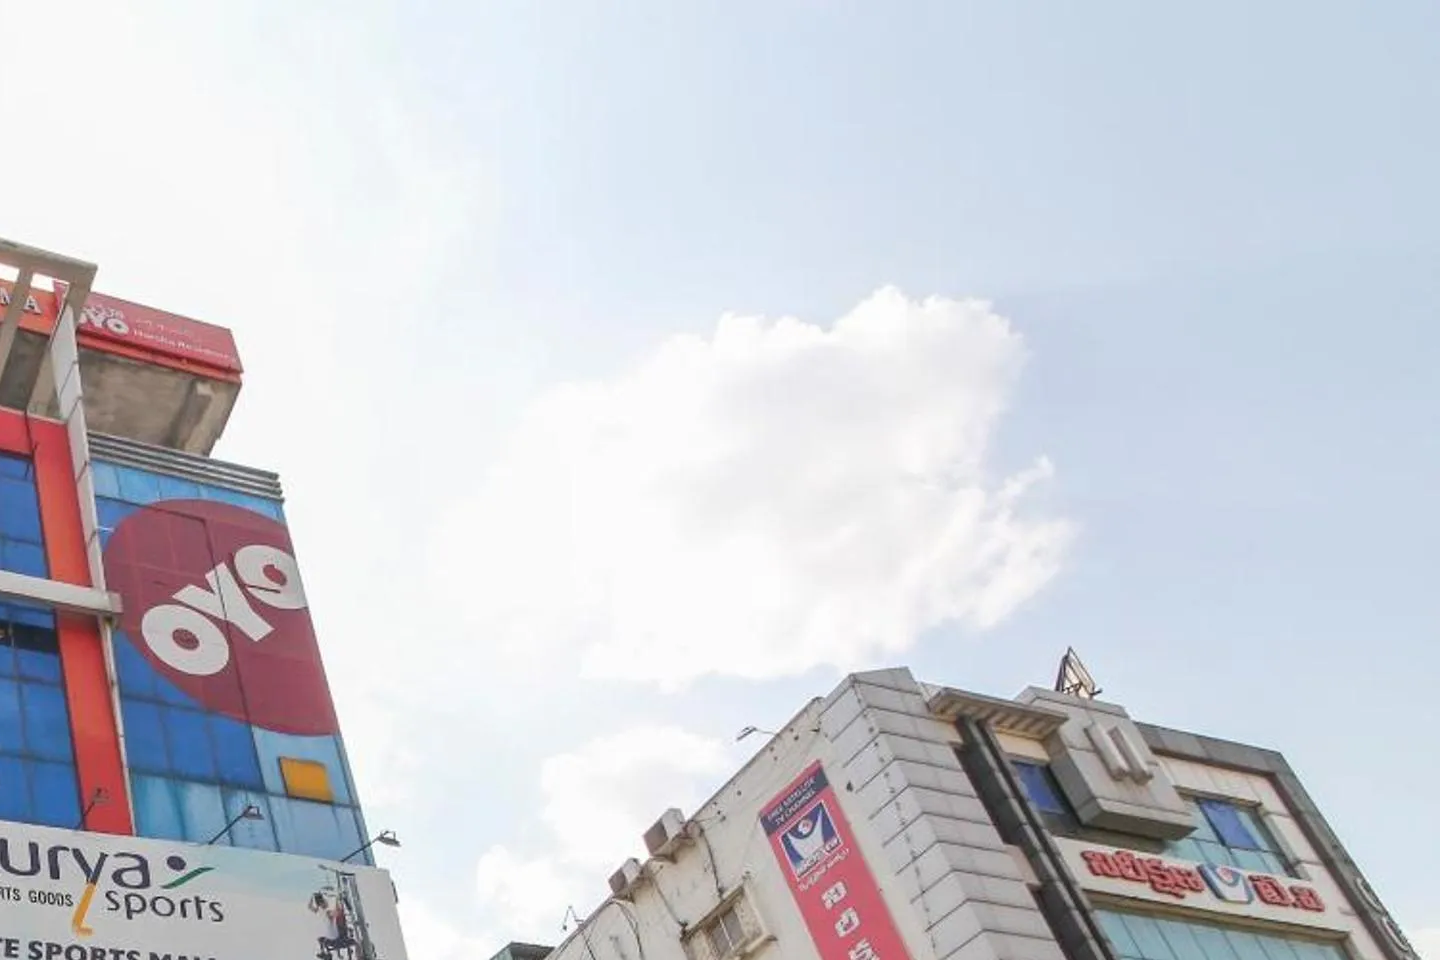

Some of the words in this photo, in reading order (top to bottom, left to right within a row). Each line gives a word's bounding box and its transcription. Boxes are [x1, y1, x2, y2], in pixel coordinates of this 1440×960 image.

[141, 545, 309, 675] OYO
[28, 887, 74, 907] GOODS
[105, 889, 225, 923] sports
